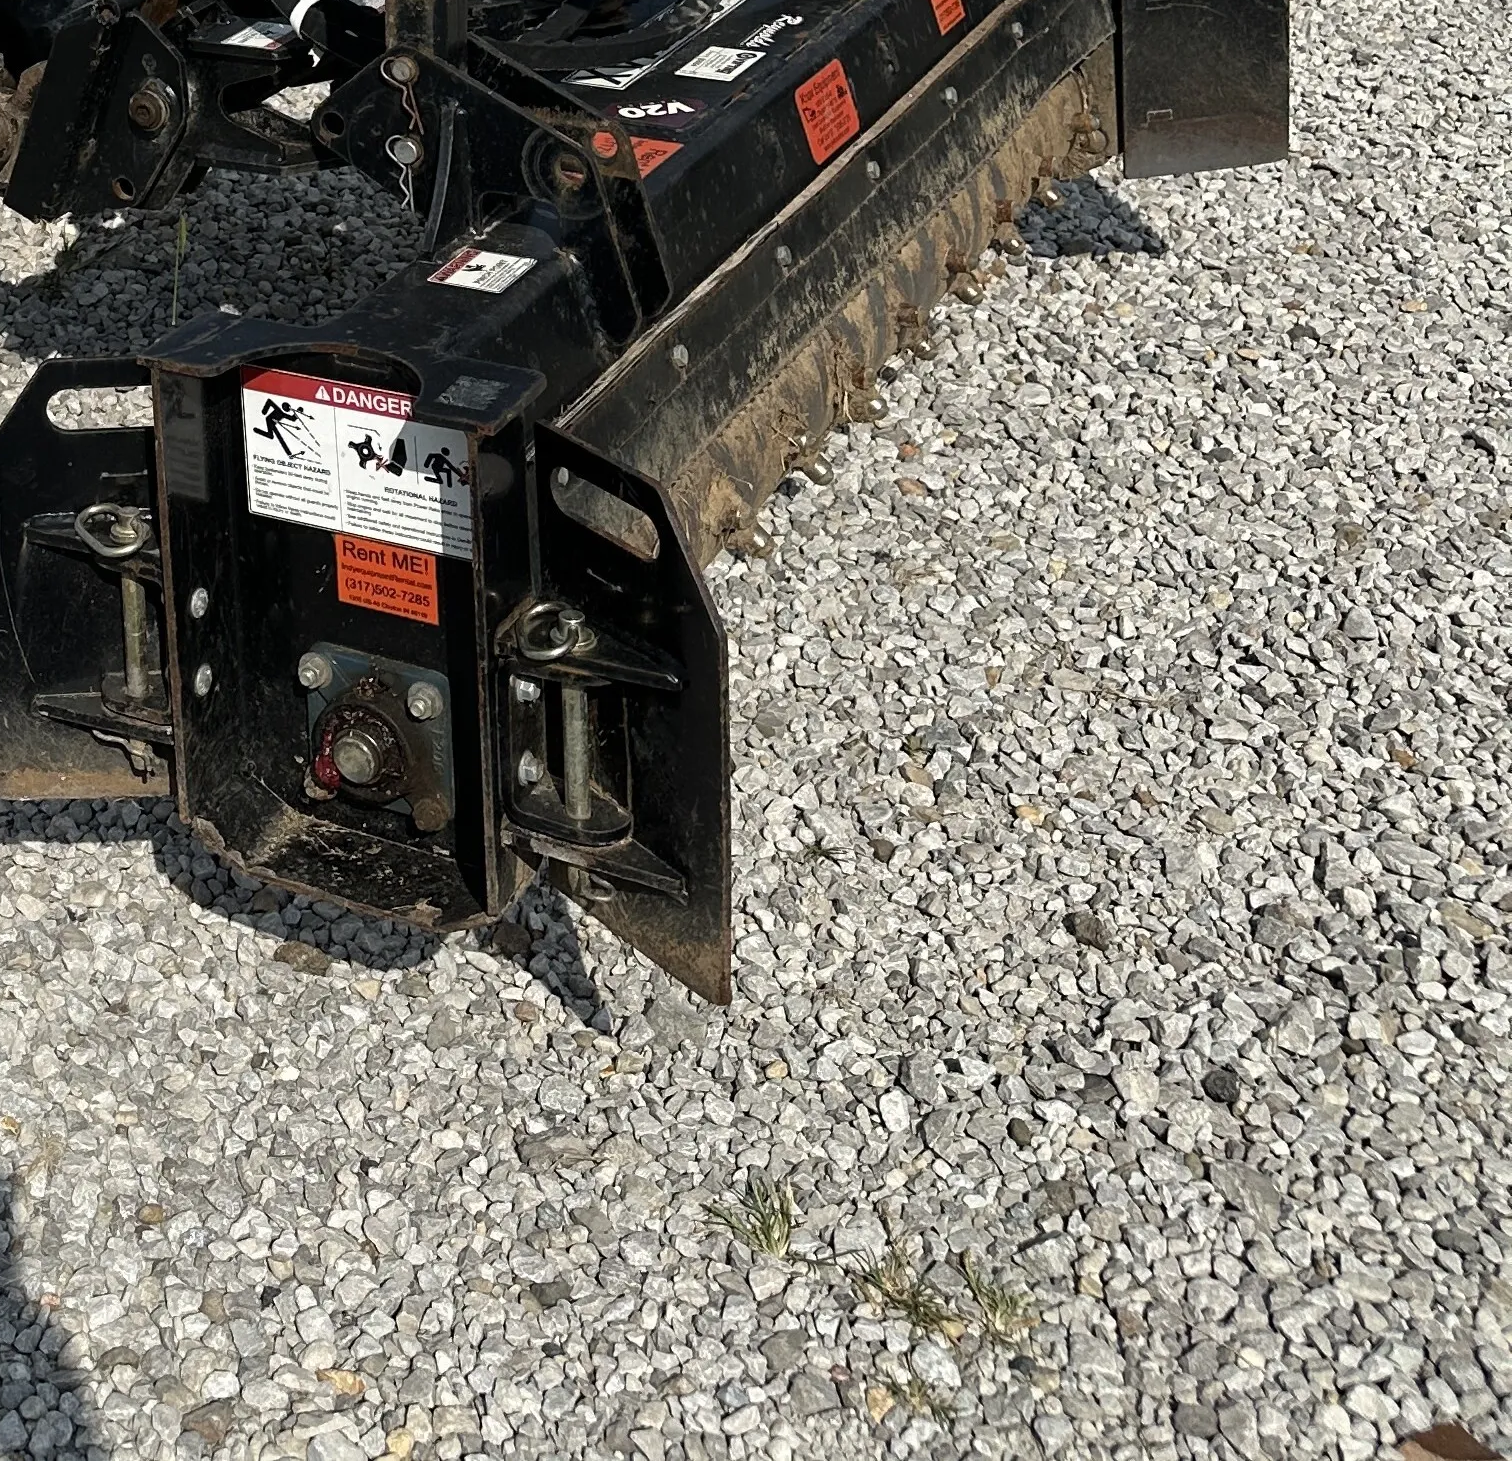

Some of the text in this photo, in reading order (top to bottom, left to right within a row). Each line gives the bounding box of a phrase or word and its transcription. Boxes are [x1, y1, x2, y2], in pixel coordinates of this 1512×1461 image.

[618, 101, 696, 119] V20
[333, 385, 414, 416] DANGER
[303, 464, 332, 477] HAZARD
[384, 486, 428, 502] ROTATIONAL
[428, 495, 458, 507] HAZARD
[342, 539, 429, 577] Rent ME!
[345, 577, 431, 608] (317)502-7285
